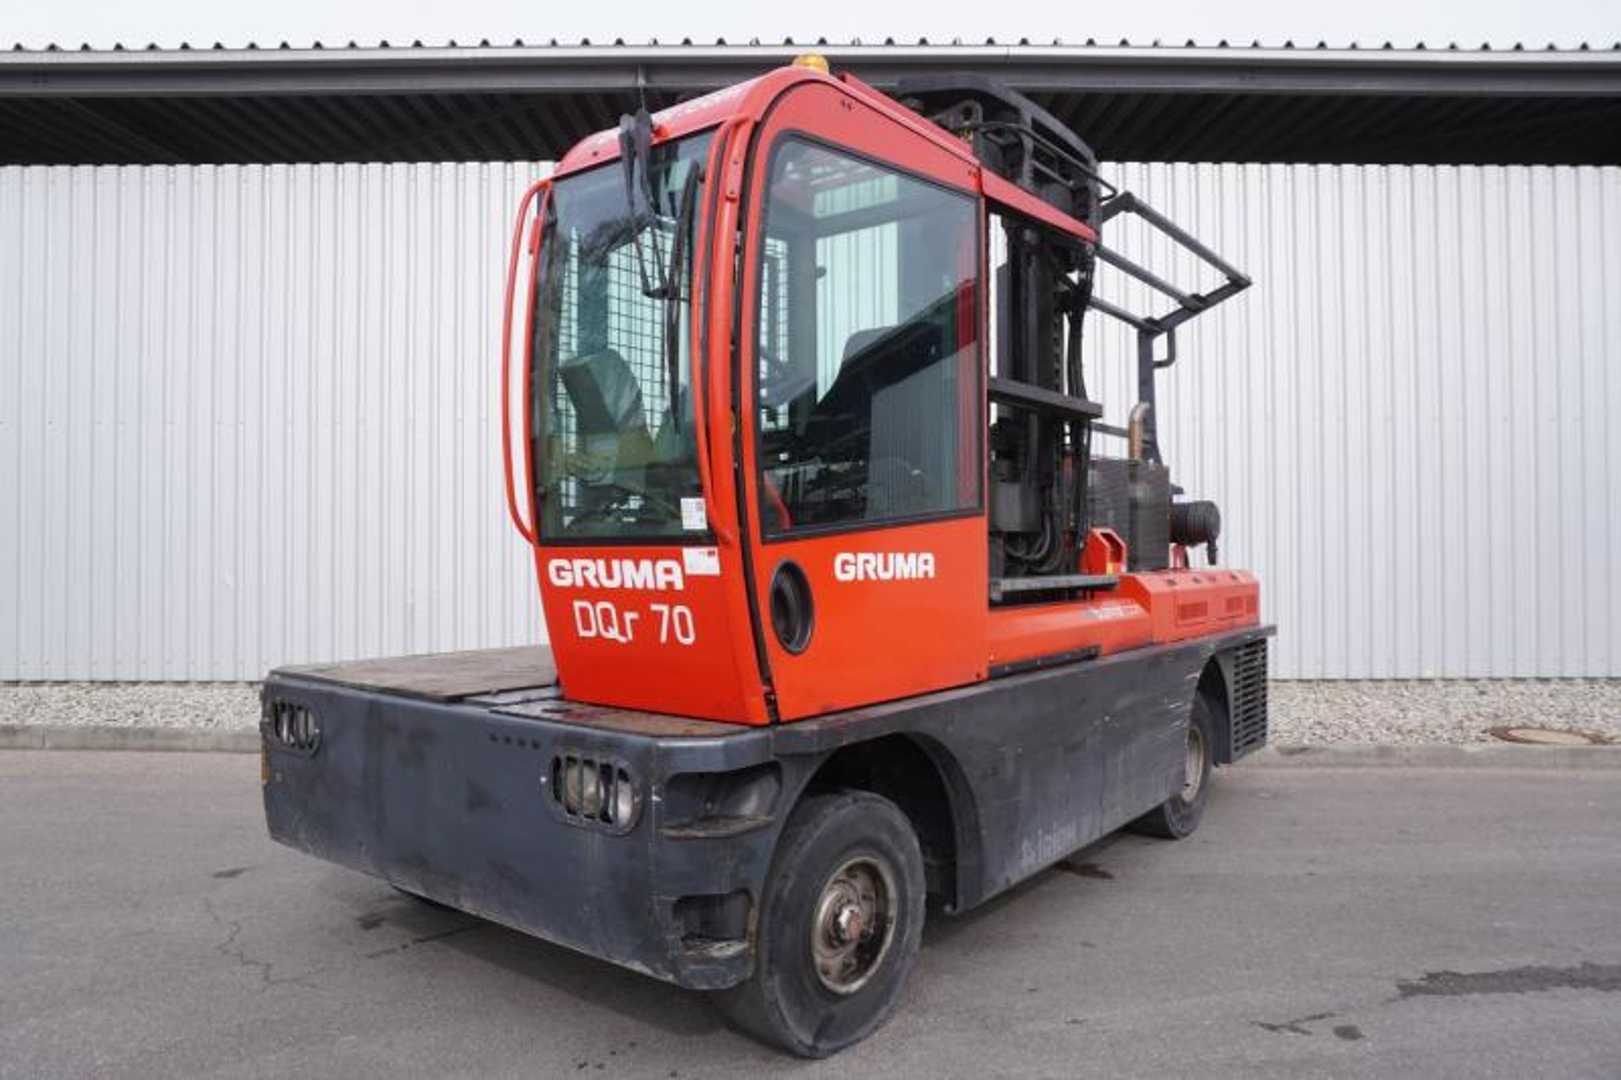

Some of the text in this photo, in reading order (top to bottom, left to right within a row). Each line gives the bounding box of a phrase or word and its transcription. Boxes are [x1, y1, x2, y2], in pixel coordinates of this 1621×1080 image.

[548, 558, 684, 591] GRUMA
[834, 552, 936, 582] GRUMA
[573, 600, 695, 645] DQr 70
